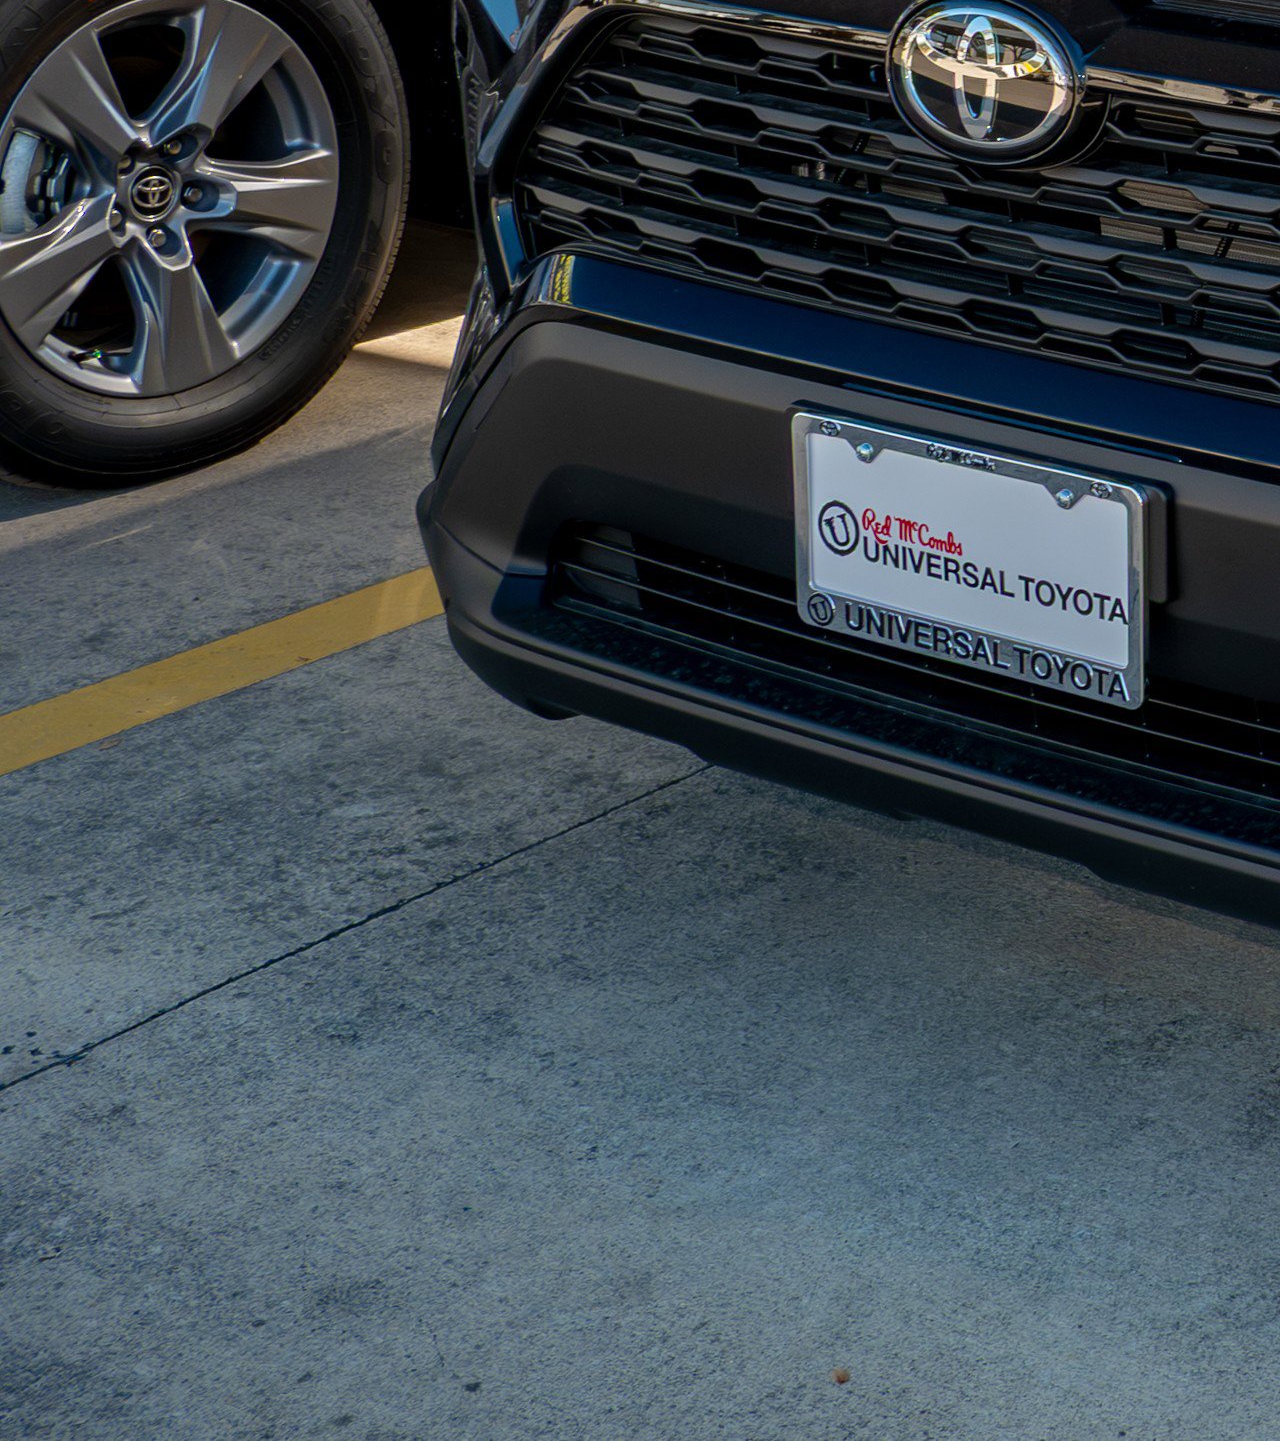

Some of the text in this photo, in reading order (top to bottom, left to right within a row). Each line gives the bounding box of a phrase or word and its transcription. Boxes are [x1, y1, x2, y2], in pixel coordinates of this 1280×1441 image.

[862, 508, 964, 556] Red McCombs
[862, 535, 1130, 625] UNIVERSAL TOYOTA
[844, 600, 1131, 702] UNIVERSAL TOYOTA
